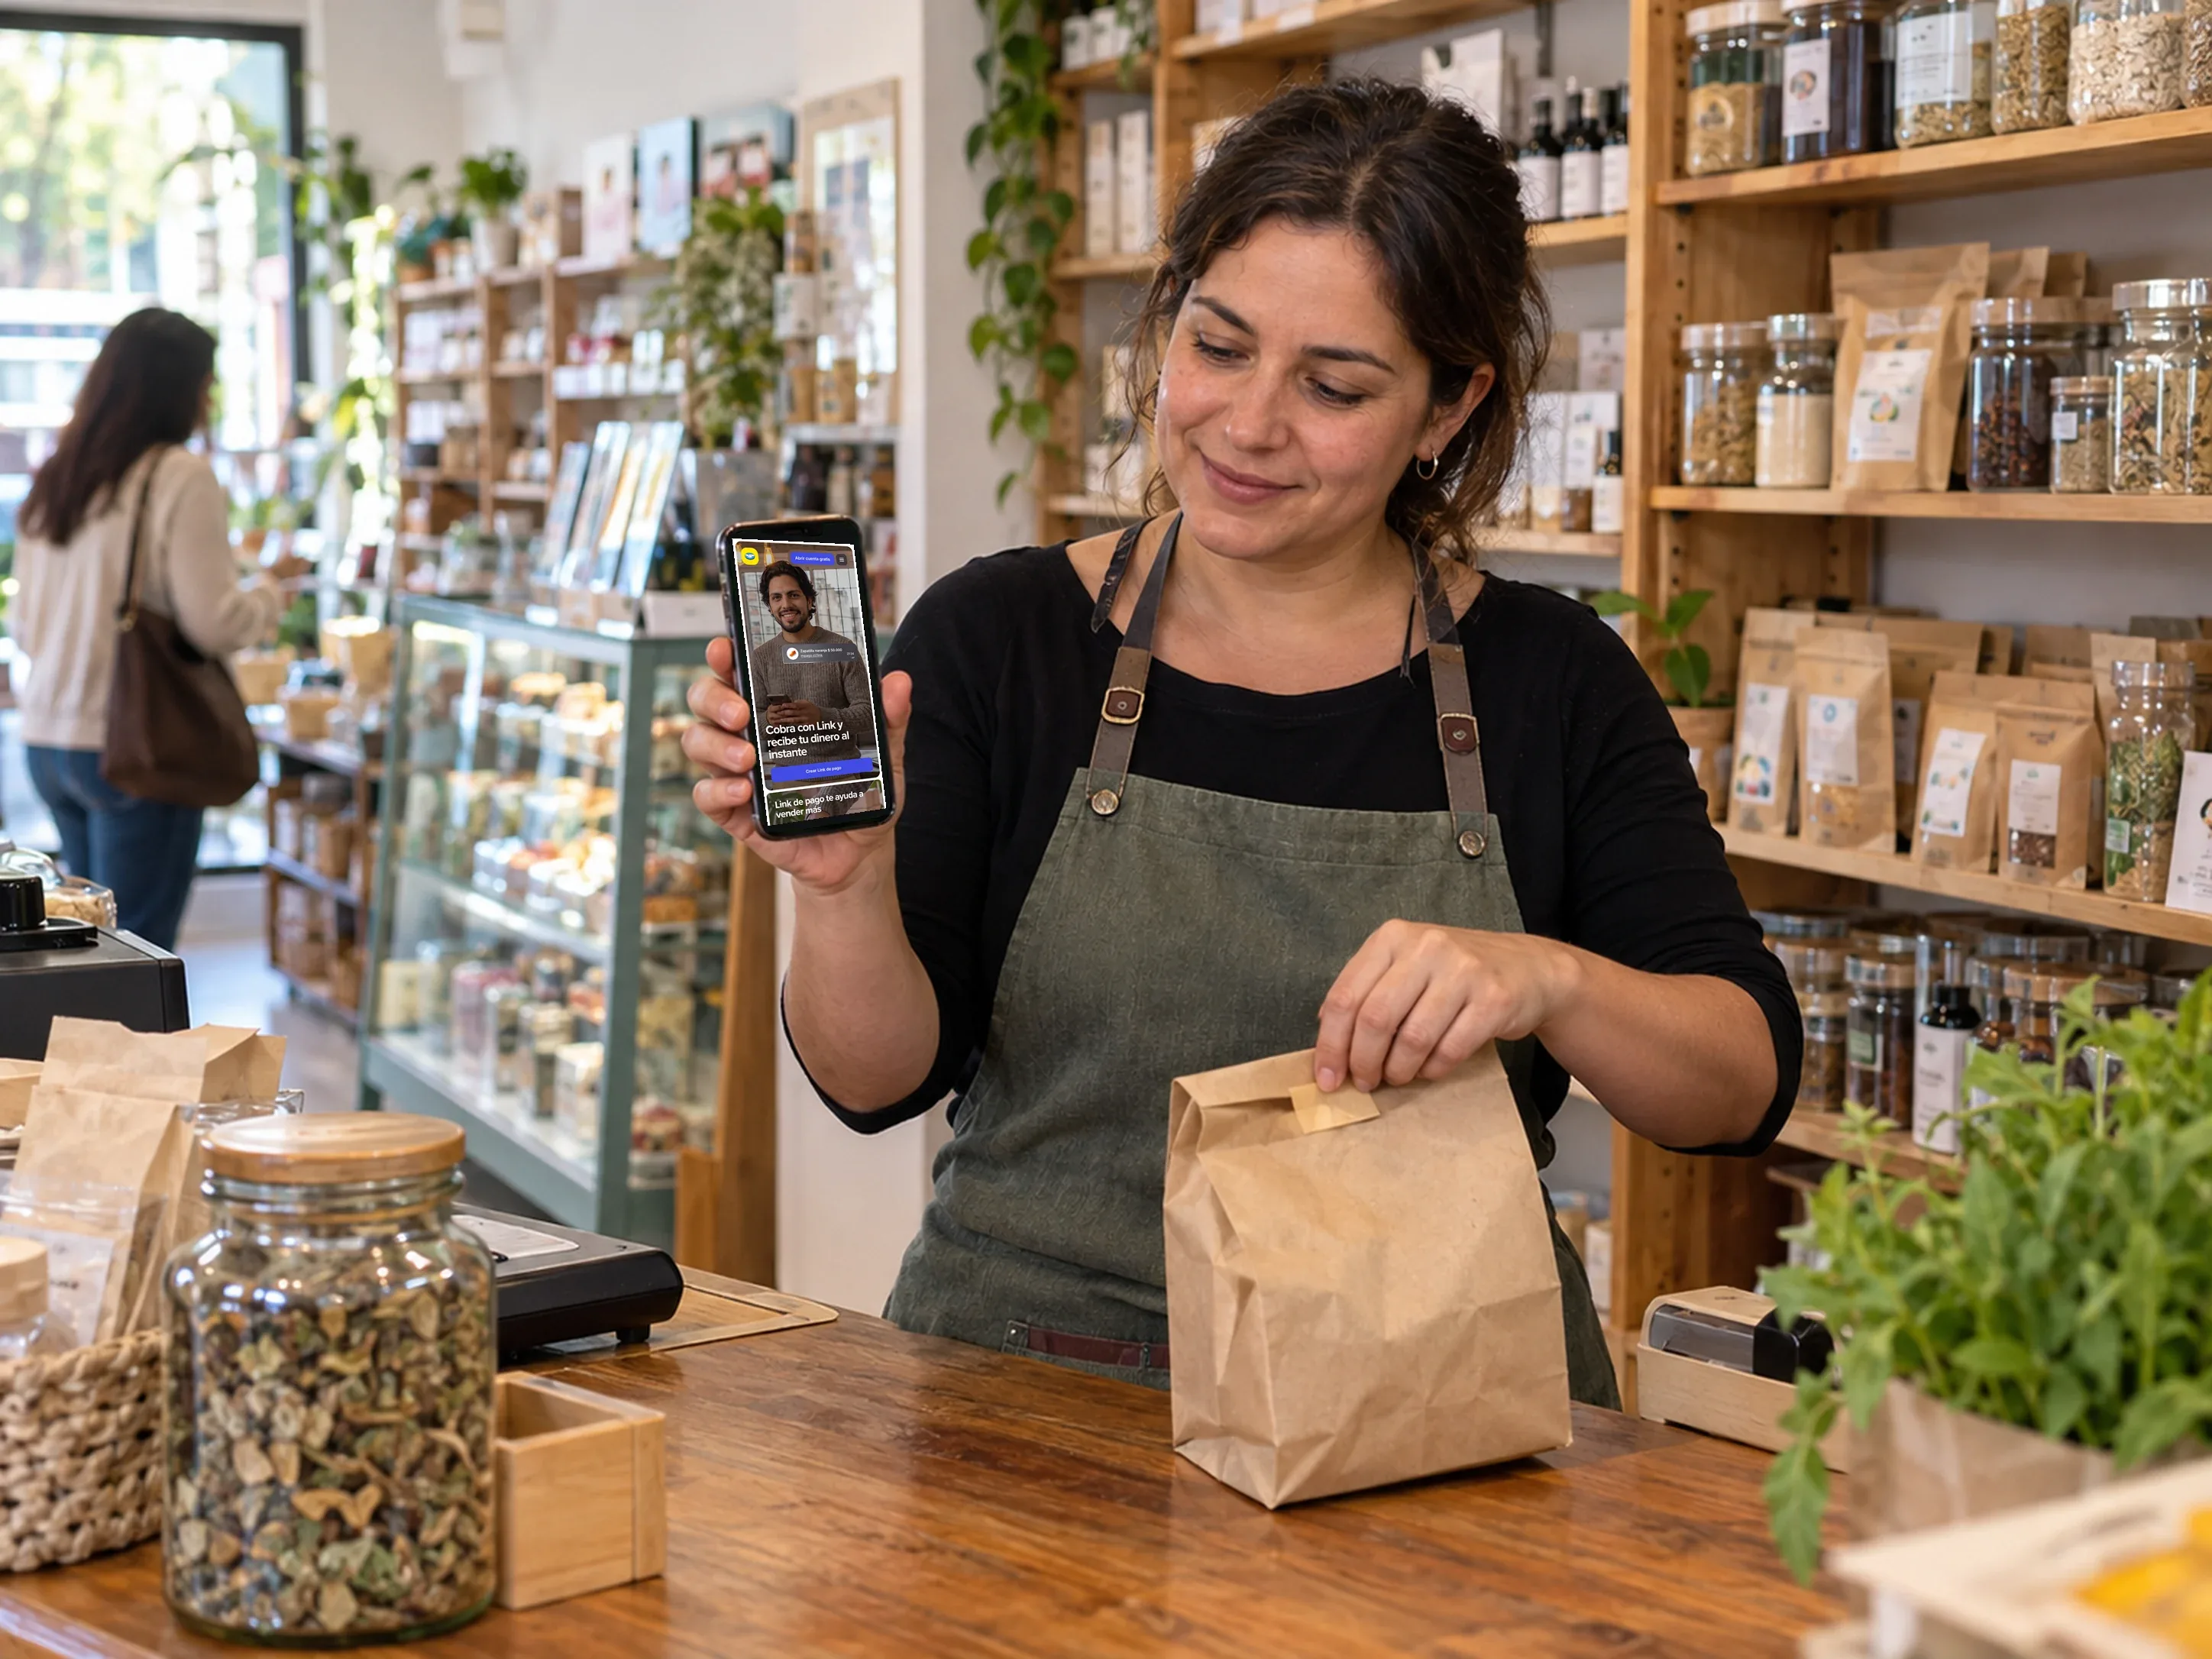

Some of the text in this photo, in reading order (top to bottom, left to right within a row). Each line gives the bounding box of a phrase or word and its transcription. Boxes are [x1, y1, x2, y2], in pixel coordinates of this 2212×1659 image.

[765, 725, 796, 734] Cobra
[817, 721, 836, 730] Link
[837, 722, 843, 731] y
[767, 731, 850, 747] recibe tu dinero al
[768, 748, 807, 759] instante
[775, 800, 792, 808] Link
[805, 797, 824, 806] pago
[835, 791, 857, 802] ayuda
[776, 805, 822, 818] vender más
